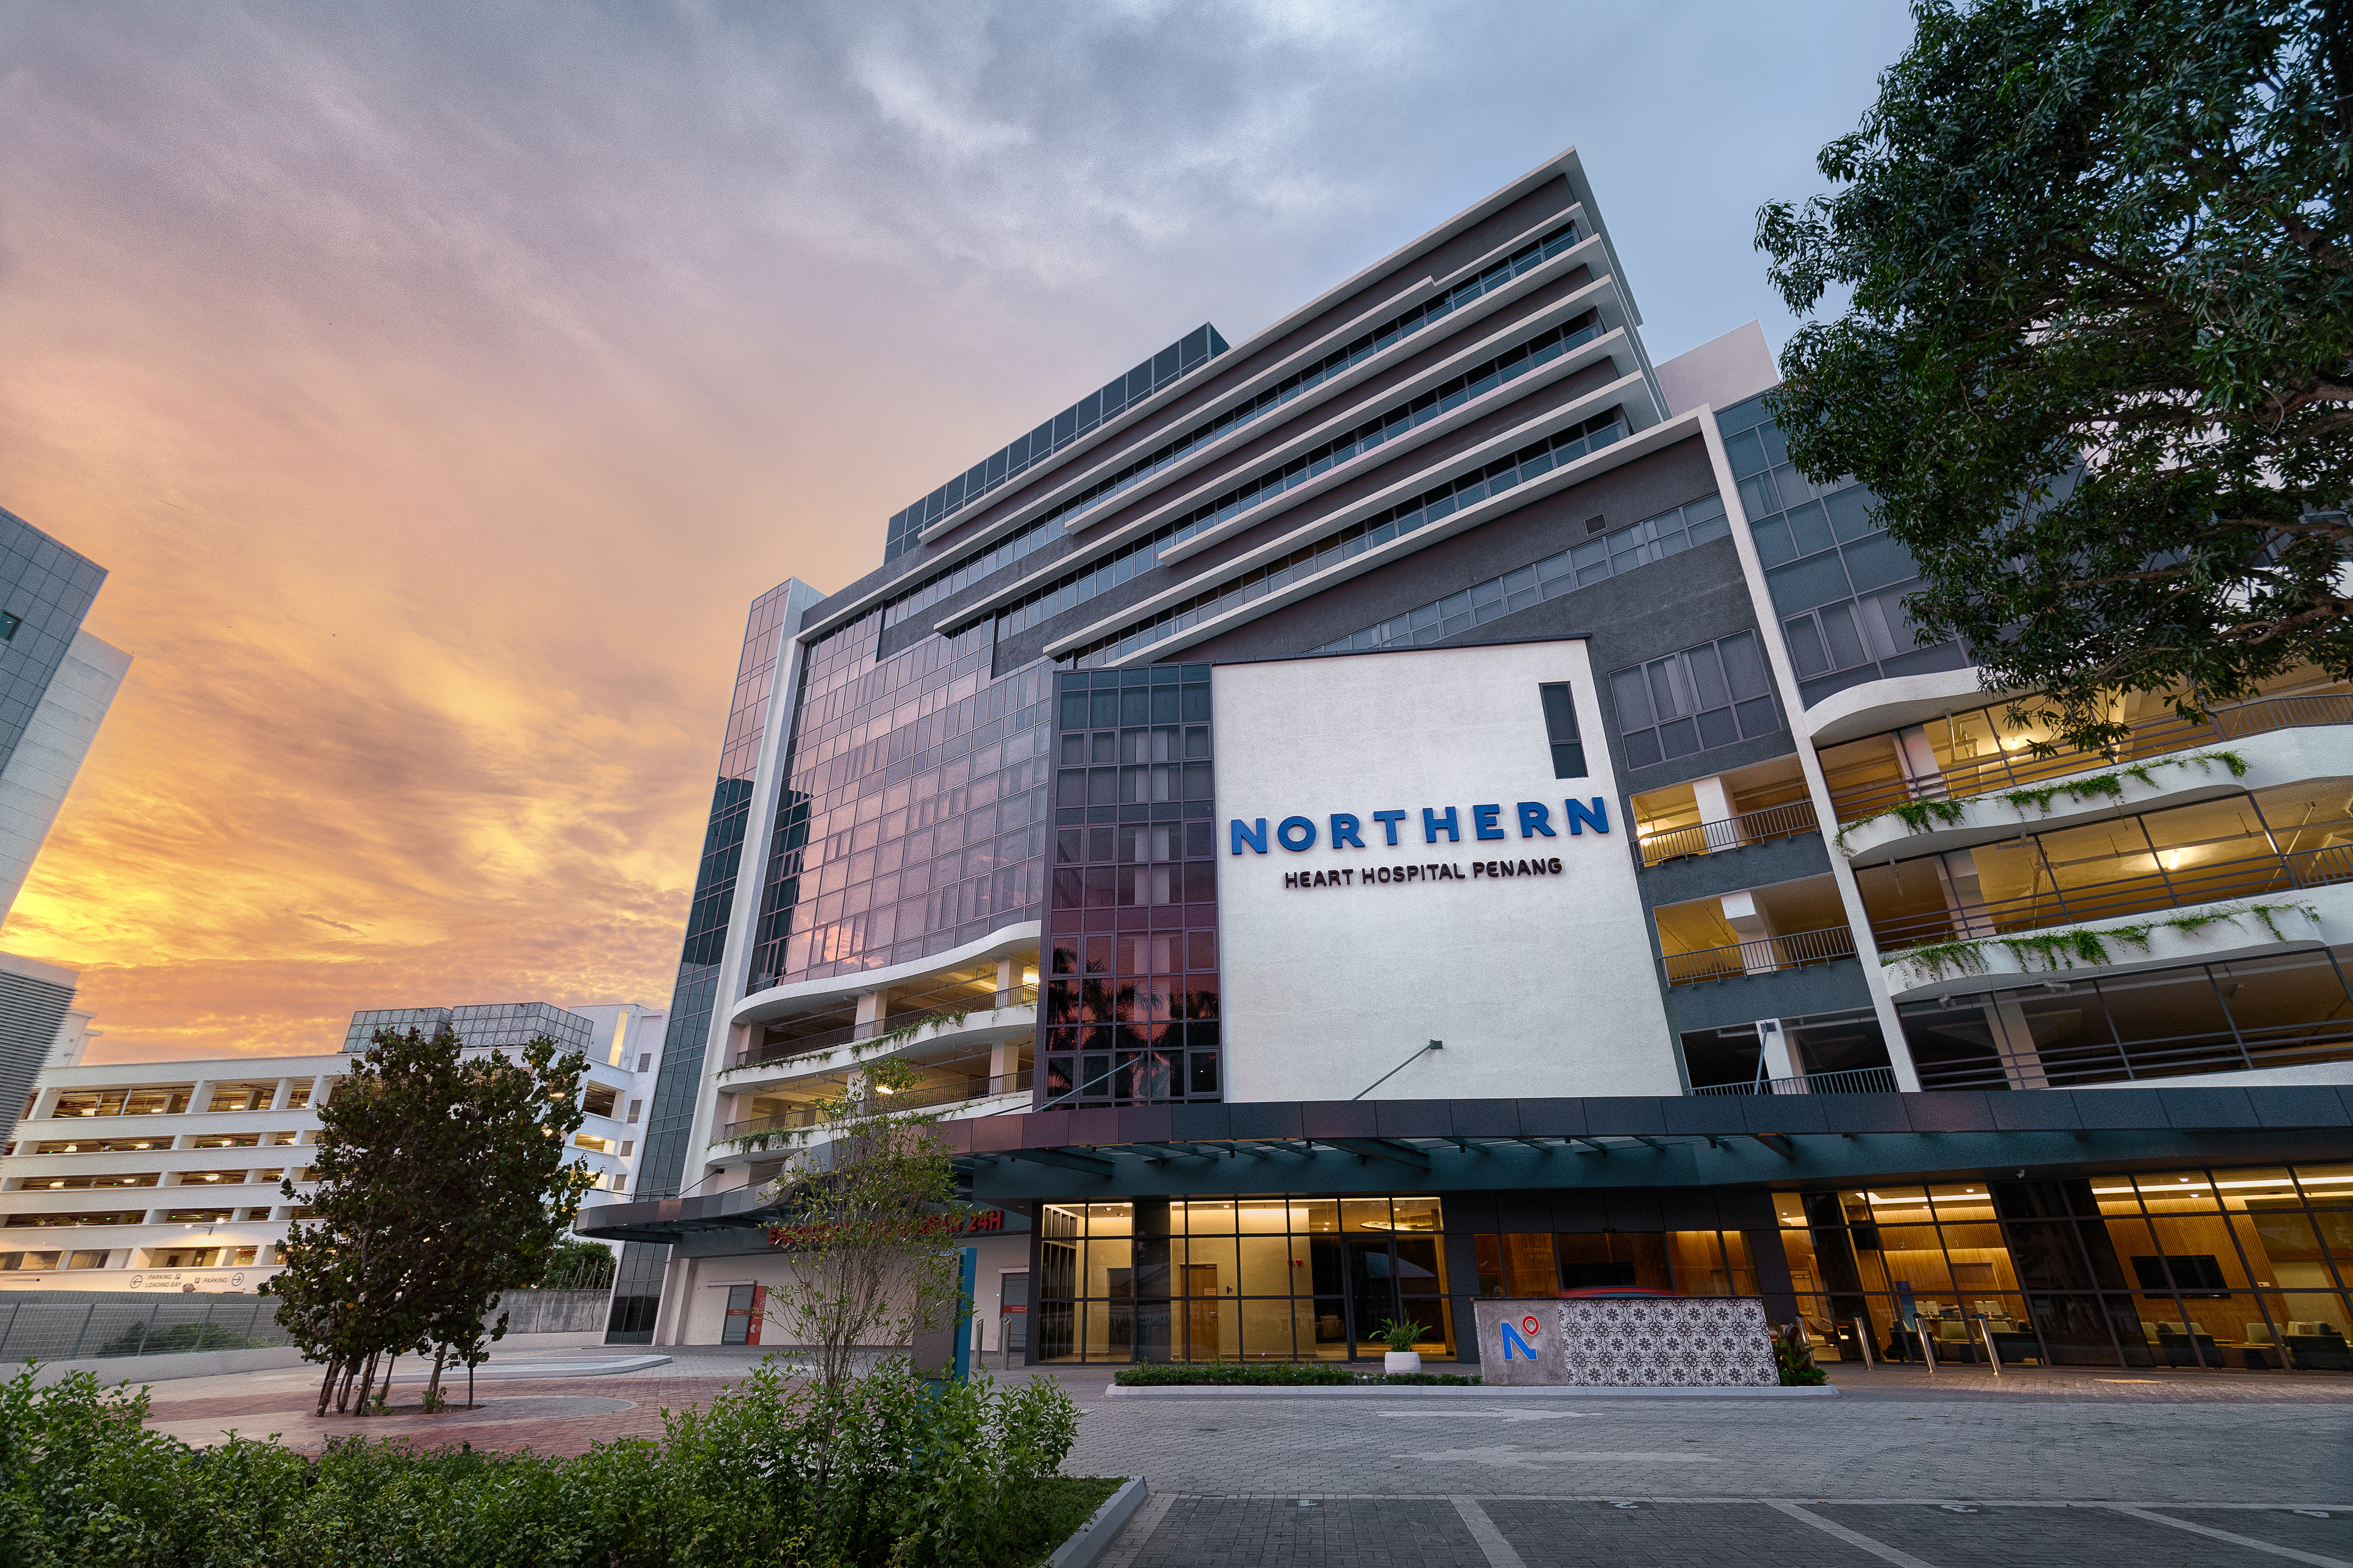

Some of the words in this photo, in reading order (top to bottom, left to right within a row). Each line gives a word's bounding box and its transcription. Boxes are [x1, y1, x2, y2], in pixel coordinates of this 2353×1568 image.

[1230, 797, 1609, 855] NORTHERN
[1285, 868, 1354, 888] HEART
[1362, 862, 1465, 884] HOSPITAL
[1473, 857, 1563, 879] PENANG
[768, 1222, 852, 1245] EMERGE
[967, 1210, 1003, 1231] 24H
